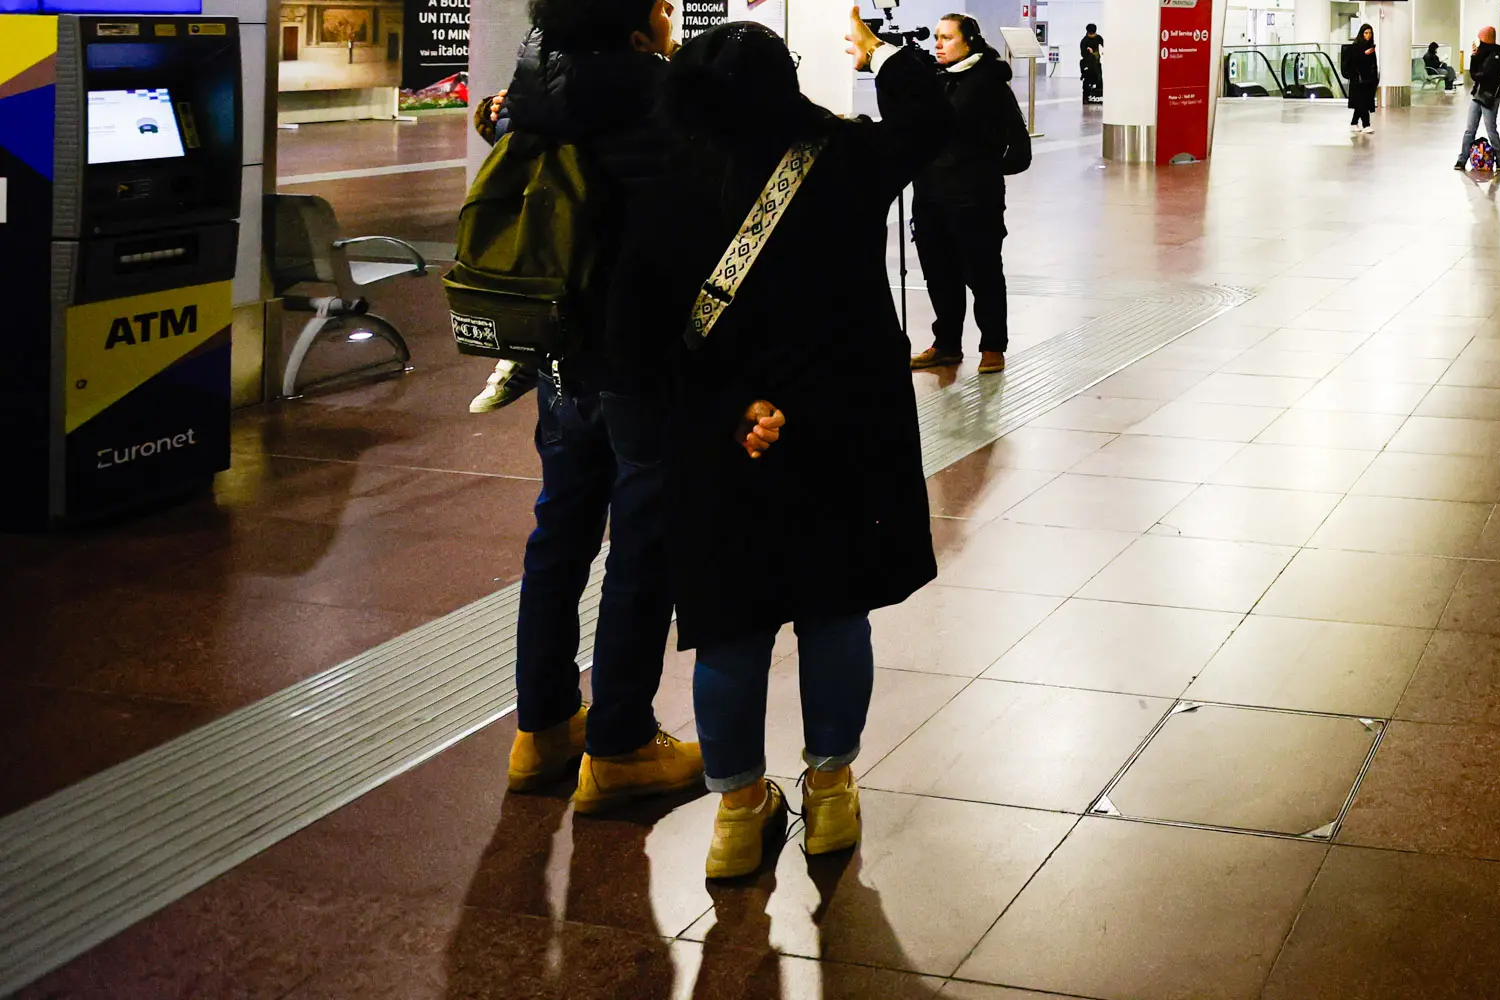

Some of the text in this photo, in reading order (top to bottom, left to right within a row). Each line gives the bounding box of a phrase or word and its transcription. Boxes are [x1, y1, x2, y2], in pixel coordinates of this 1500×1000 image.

[686, 3, 724, 12] BOLOGNA
[418, 12, 437, 24] UN
[686, 16, 709, 26] ITALO
[432, 29, 445, 40] 10
[104, 304, 198, 350] ATM
